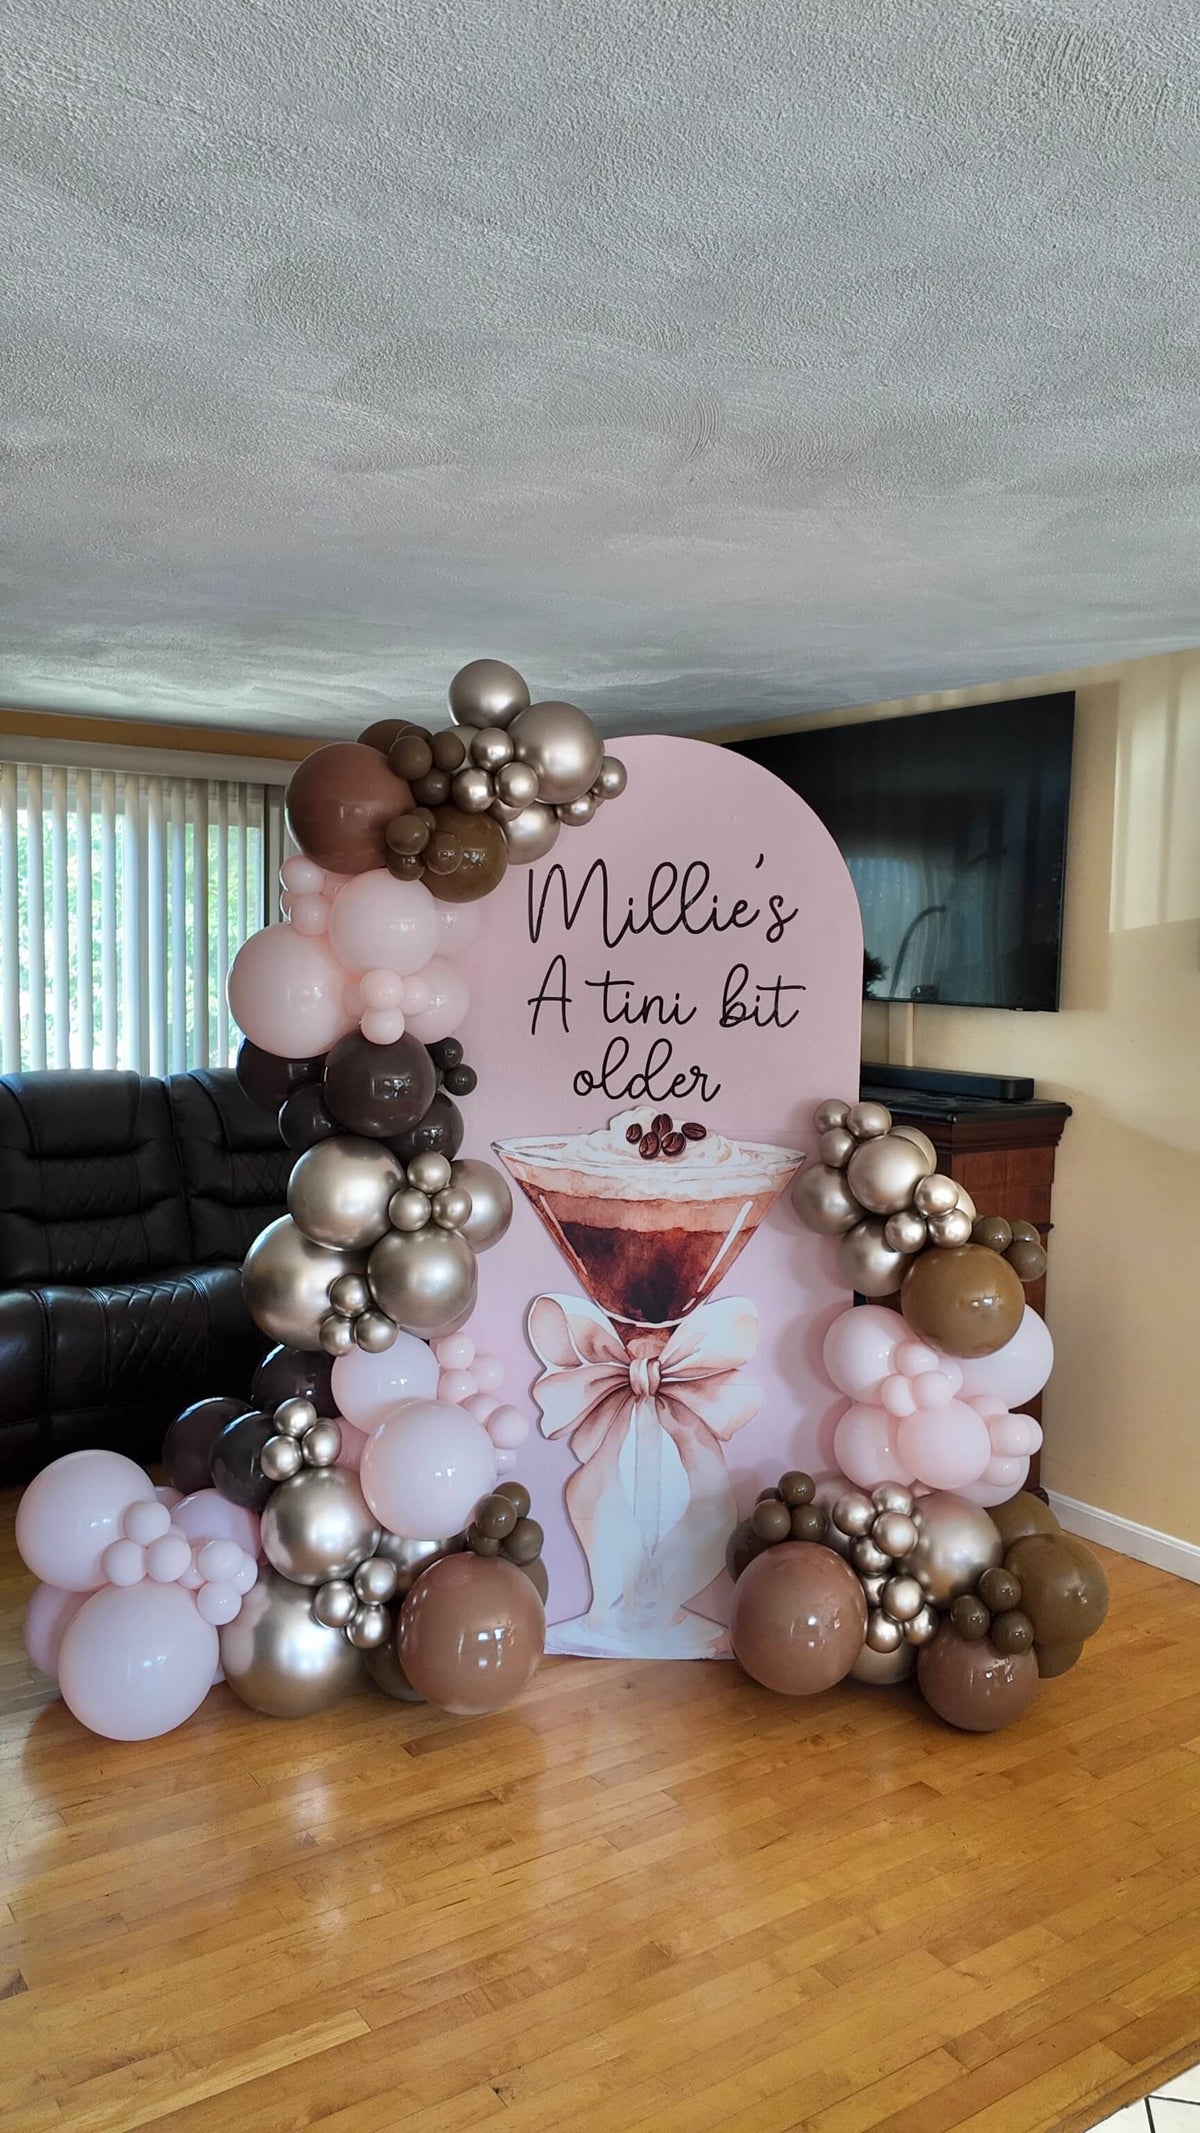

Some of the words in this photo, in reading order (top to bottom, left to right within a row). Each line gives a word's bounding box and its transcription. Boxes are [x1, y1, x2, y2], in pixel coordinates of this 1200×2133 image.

[527, 853, 799, 949] Millie's
[527, 954, 573, 1036] A
[584, 969, 698, 1026] tini
[718, 962, 807, 1029] bit
[572, 1035, 722, 1103] older
